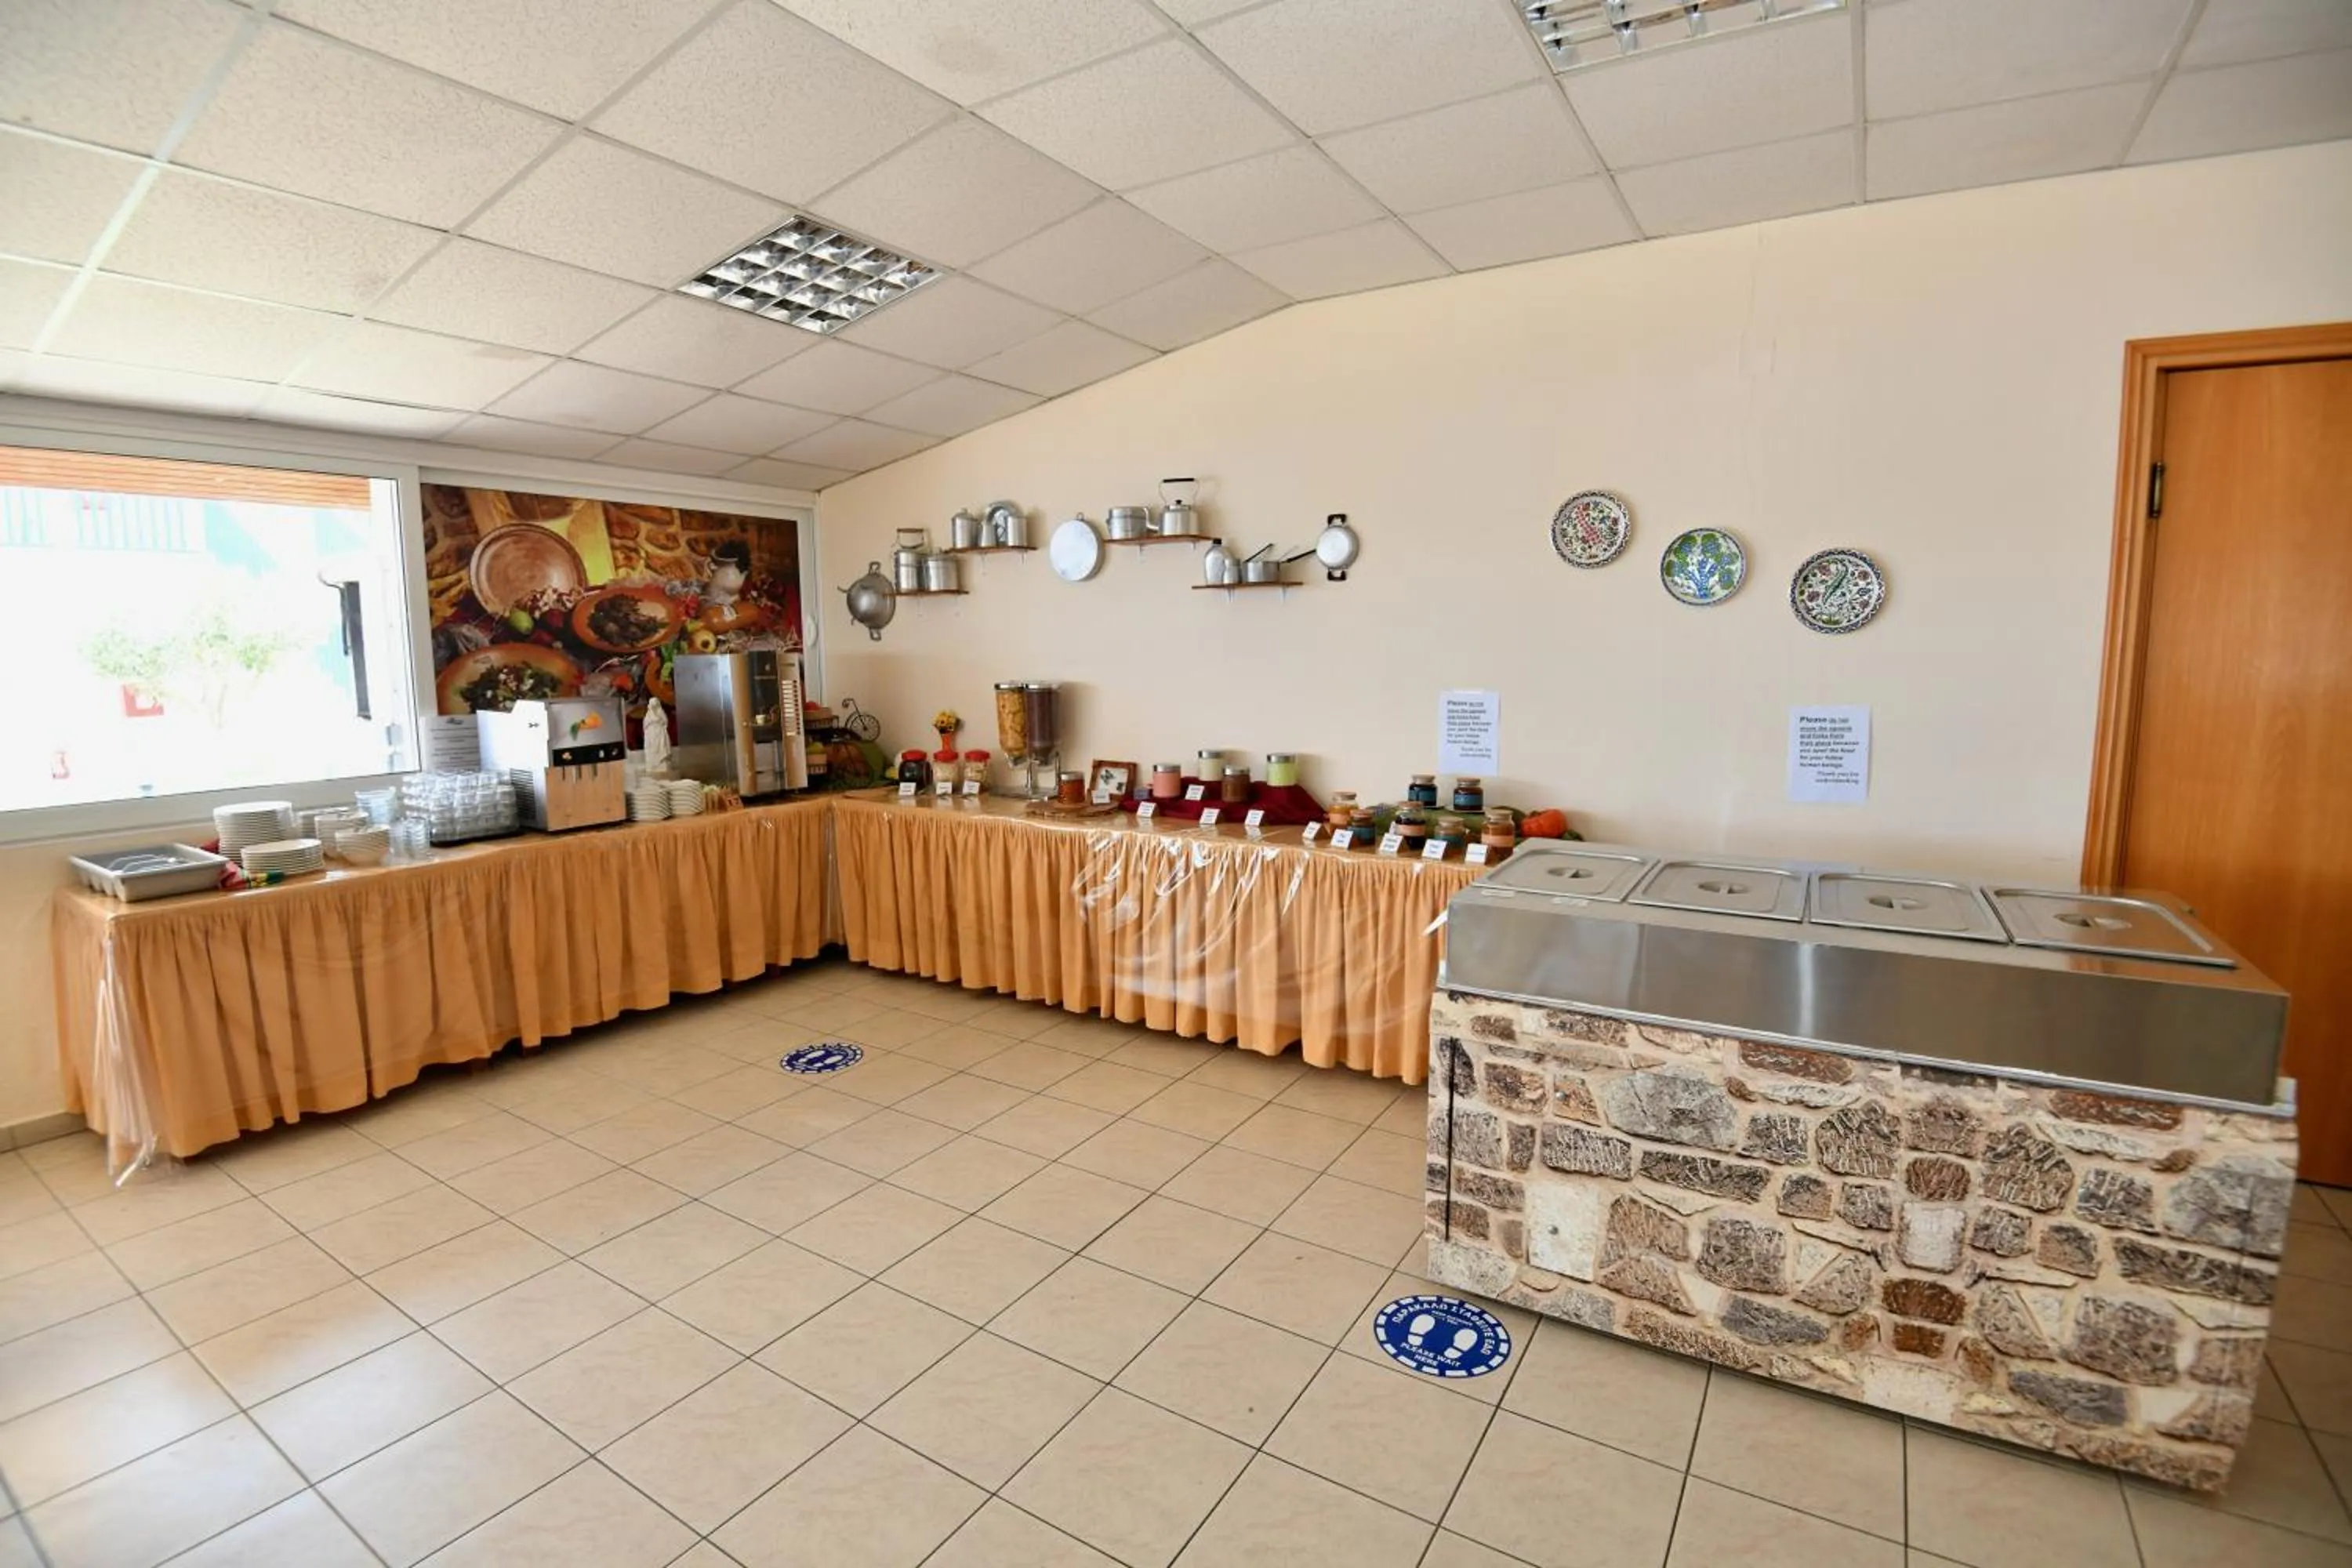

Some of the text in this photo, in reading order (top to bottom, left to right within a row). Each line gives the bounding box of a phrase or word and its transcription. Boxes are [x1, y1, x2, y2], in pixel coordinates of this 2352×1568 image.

[1400, 1342, 1461, 1367] PLEASE WAIT
[1414, 1354, 1438, 1367] HERE
